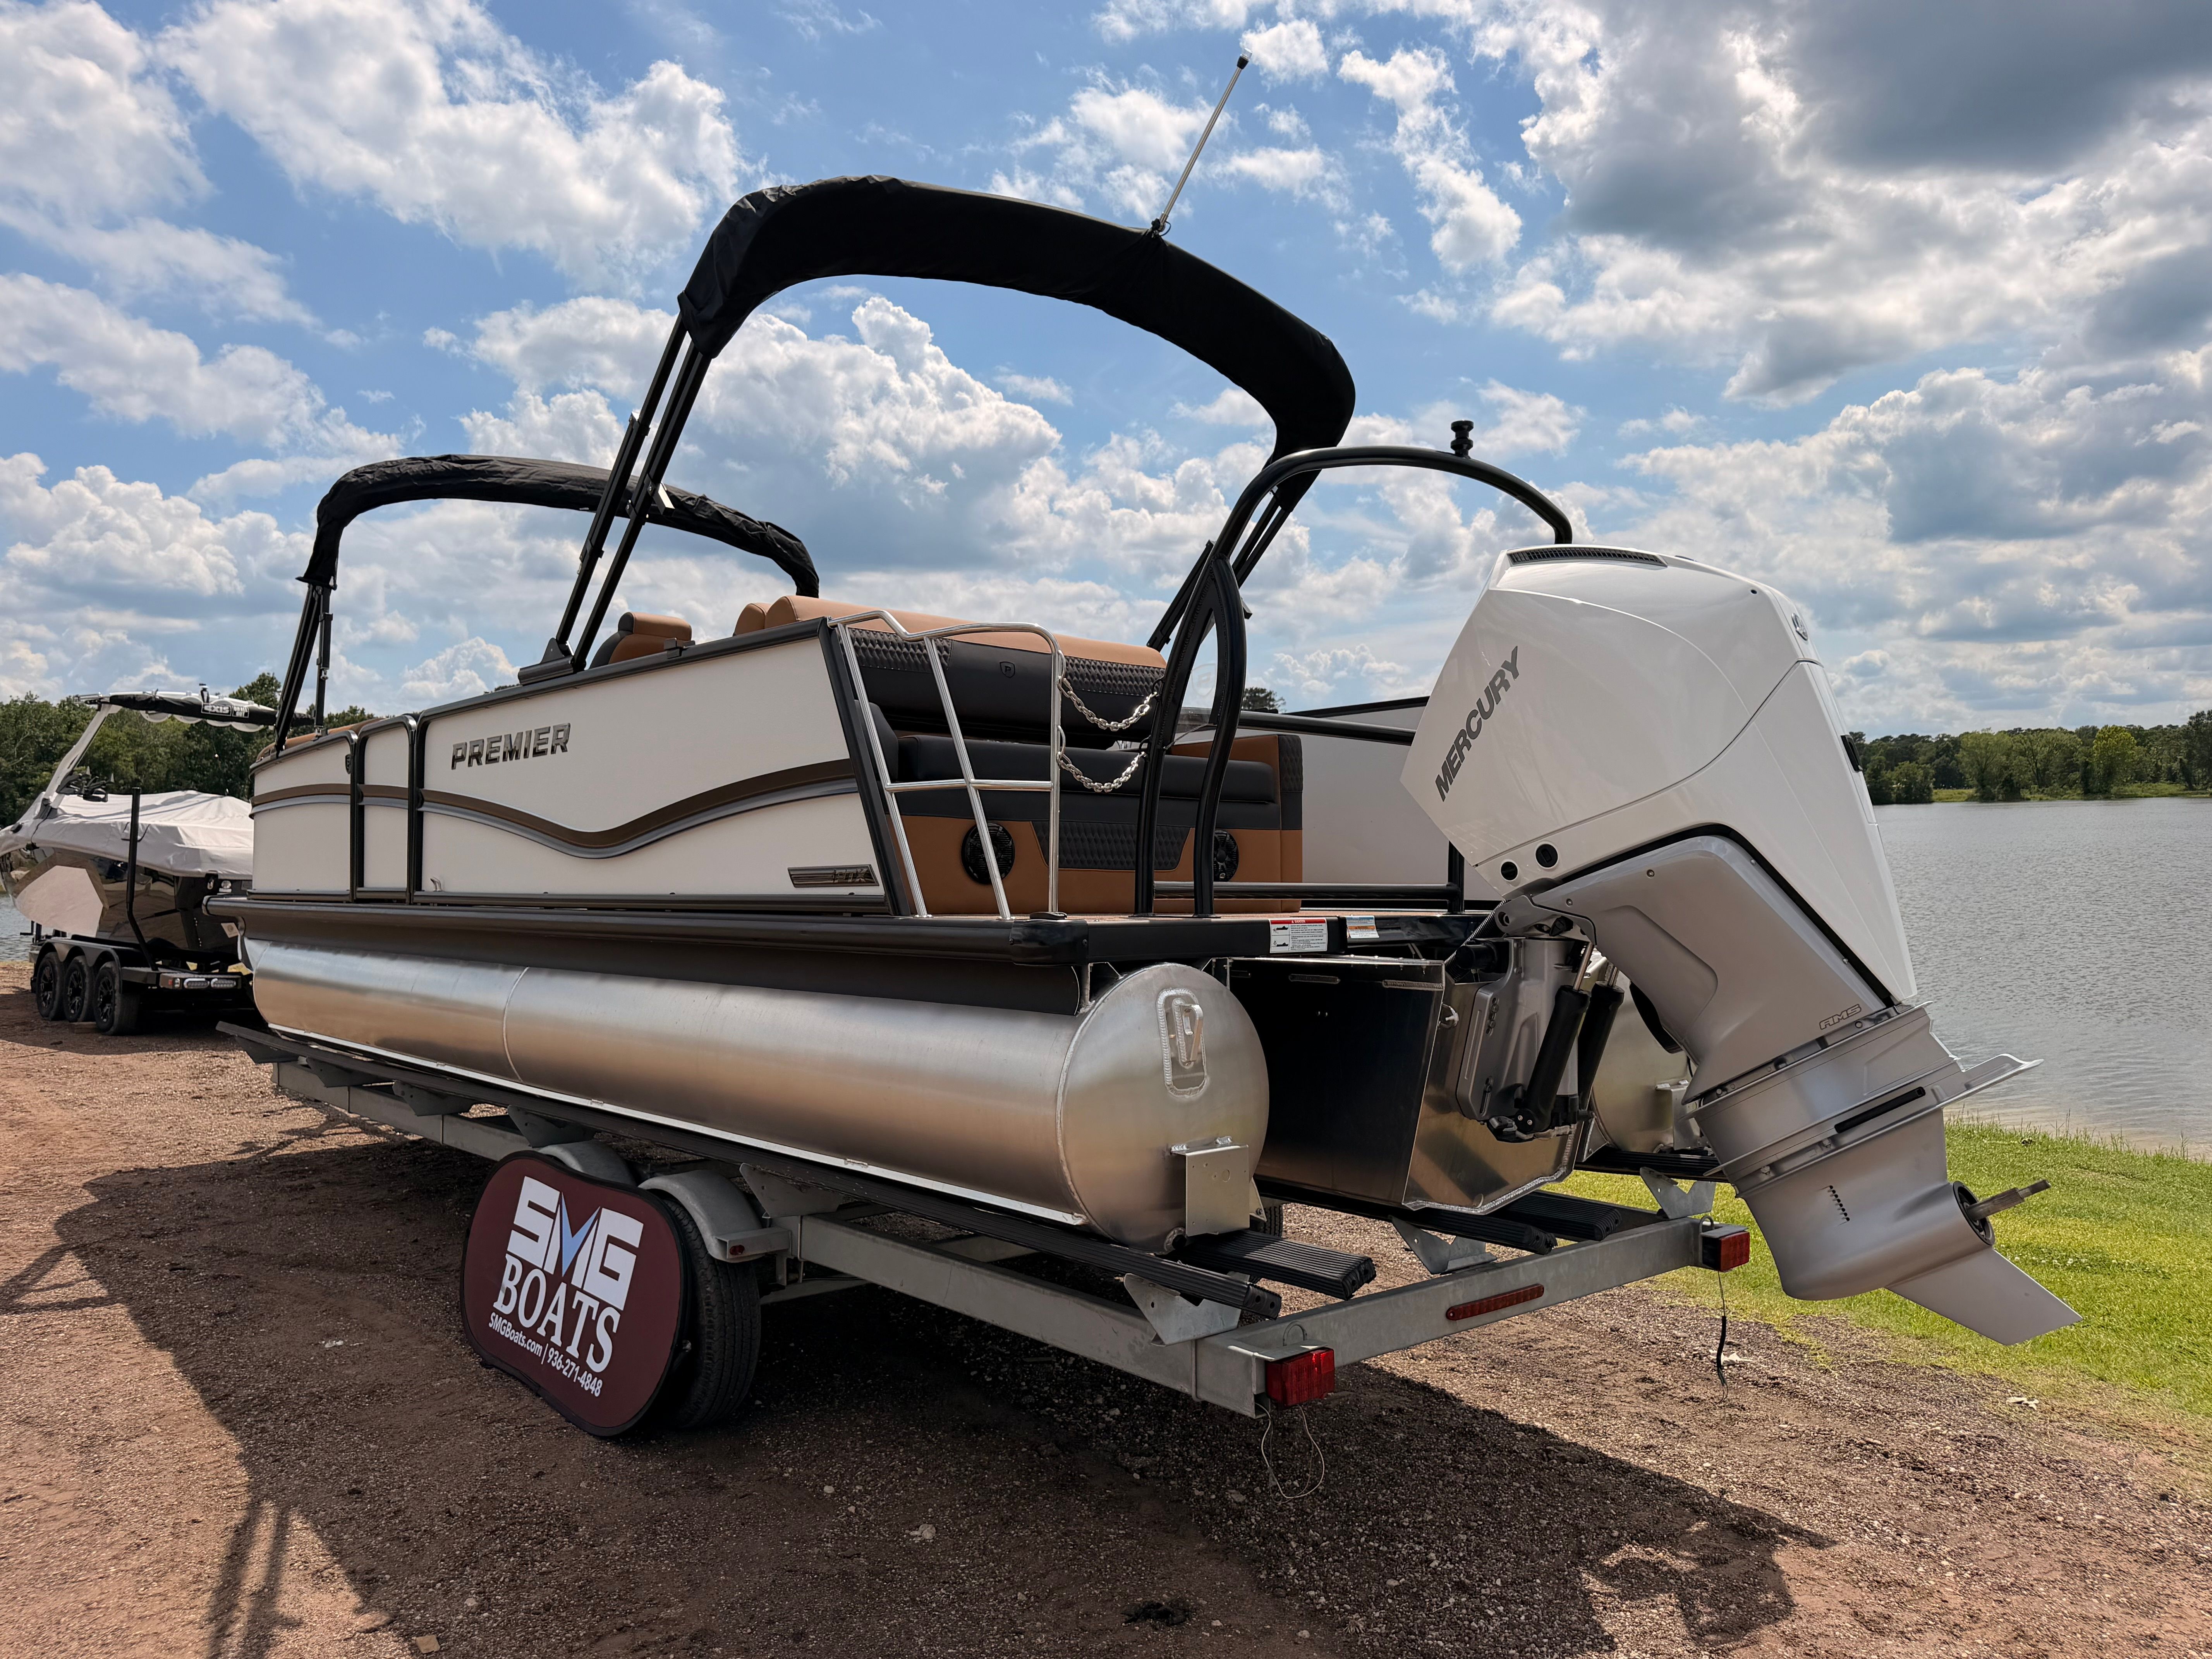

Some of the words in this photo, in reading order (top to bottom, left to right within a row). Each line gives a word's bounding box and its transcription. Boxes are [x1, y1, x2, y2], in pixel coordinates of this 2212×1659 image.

[451, 723, 571, 770] PREMIER
[1435, 646, 1519, 802] MERCURY
[1819, 1003, 1862, 1030] AMS
[507, 1176, 644, 1310] SMG
[489, 1312, 543, 1357] SMGBoats.com
[547, 1347, 603, 1397] 936-271-4848
[493, 1254, 620, 1372] BOATS
